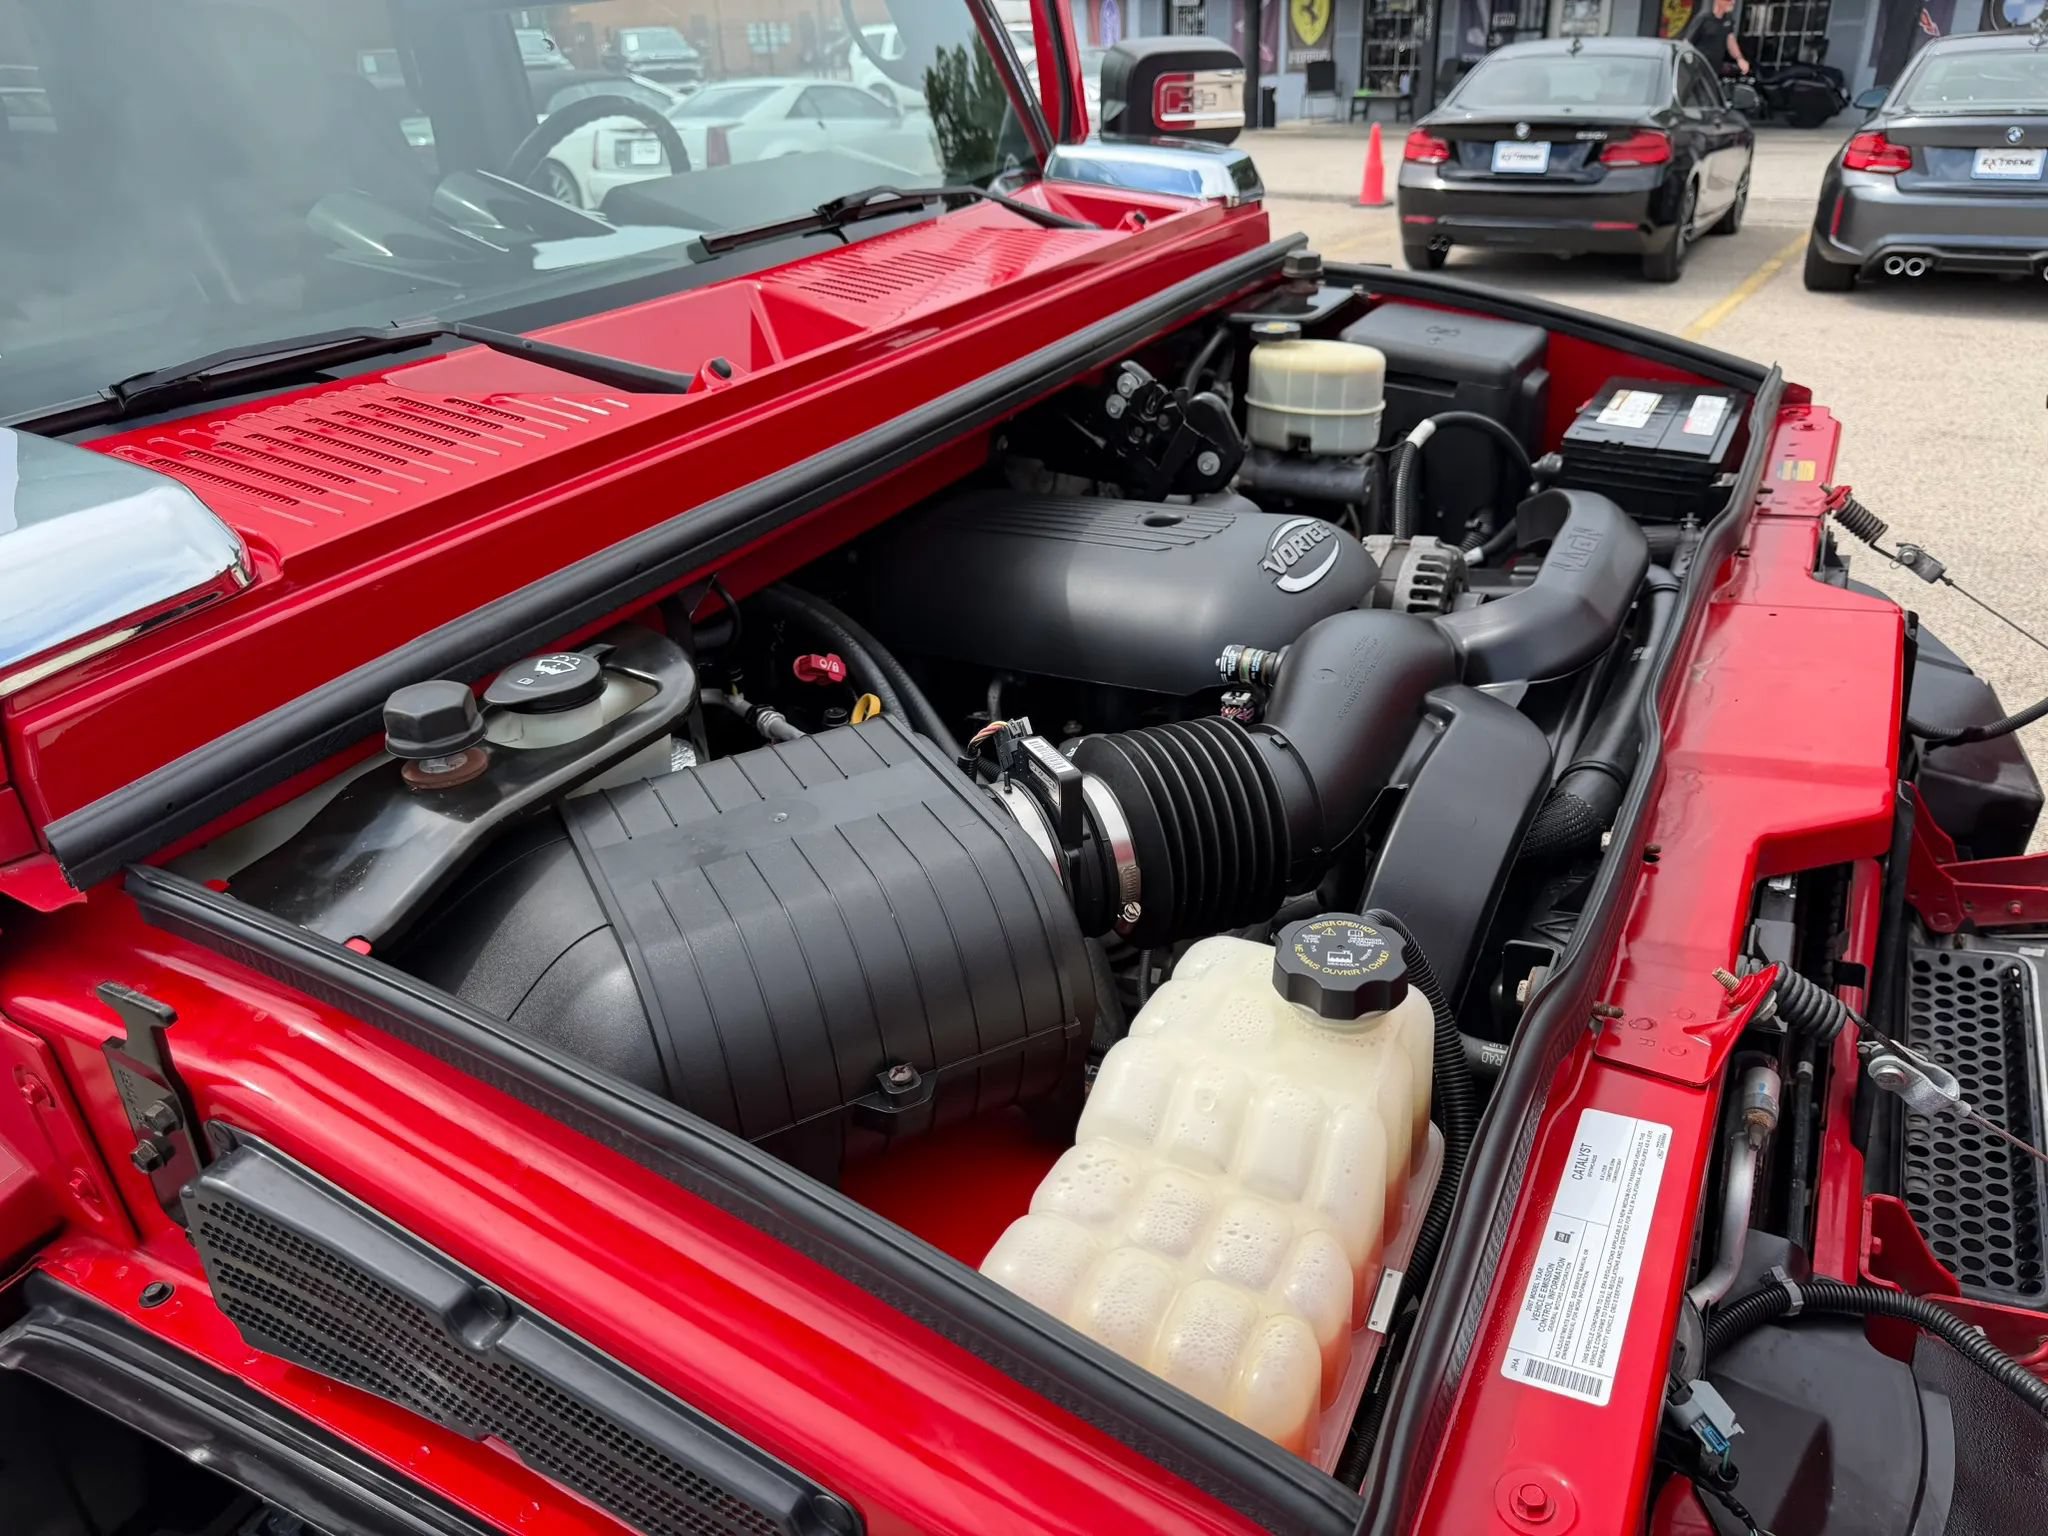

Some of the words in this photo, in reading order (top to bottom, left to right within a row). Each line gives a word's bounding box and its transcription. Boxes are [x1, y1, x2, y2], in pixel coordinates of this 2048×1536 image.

[1263, 520, 1331, 575] VORTEC
[1336, 920, 1358, 929] OPEN
[1322, 966, 1361, 976] OUVRIR
[1572, 1143, 1592, 1180] CATALYST
[1530, 1283, 1540, 1299] MODEL
[1535, 1268, 1544, 1280] YEAR
[1531, 1293, 1546, 1320] VEHICLE
[1540, 1263, 1555, 1293] EMISSION
[1538, 1302, 1553, 1332] CONTROL
[1548, 1257, 1565, 1299] INFORMATION
[1559, 1262, 1571, 1291] CORPORATION
[1585, 1332, 1594, 1352] VEHICLE
[1590, 1306, 1601, 1331] CONFORMS
[1604, 1250, 1615, 1279] REGULATIONS
[1611, 1225, 1622, 1249] APPLICABLE
[1589, 1346, 1599, 1366] VEHICLE
[1594, 1319, 1606, 1345] CONFORMS
[1603, 1292, 1613, 1311] FEDERAL
[1608, 1260, 1620, 1290] REGULATIONS
[1620, 1225, 1629, 1245] CERTIFIED
[1557, 1319, 1570, 1350] ADJUSTMENTS
[1574, 1273, 1582, 1289] SERVICE
[1511, 1359, 1520, 1371] JHA
